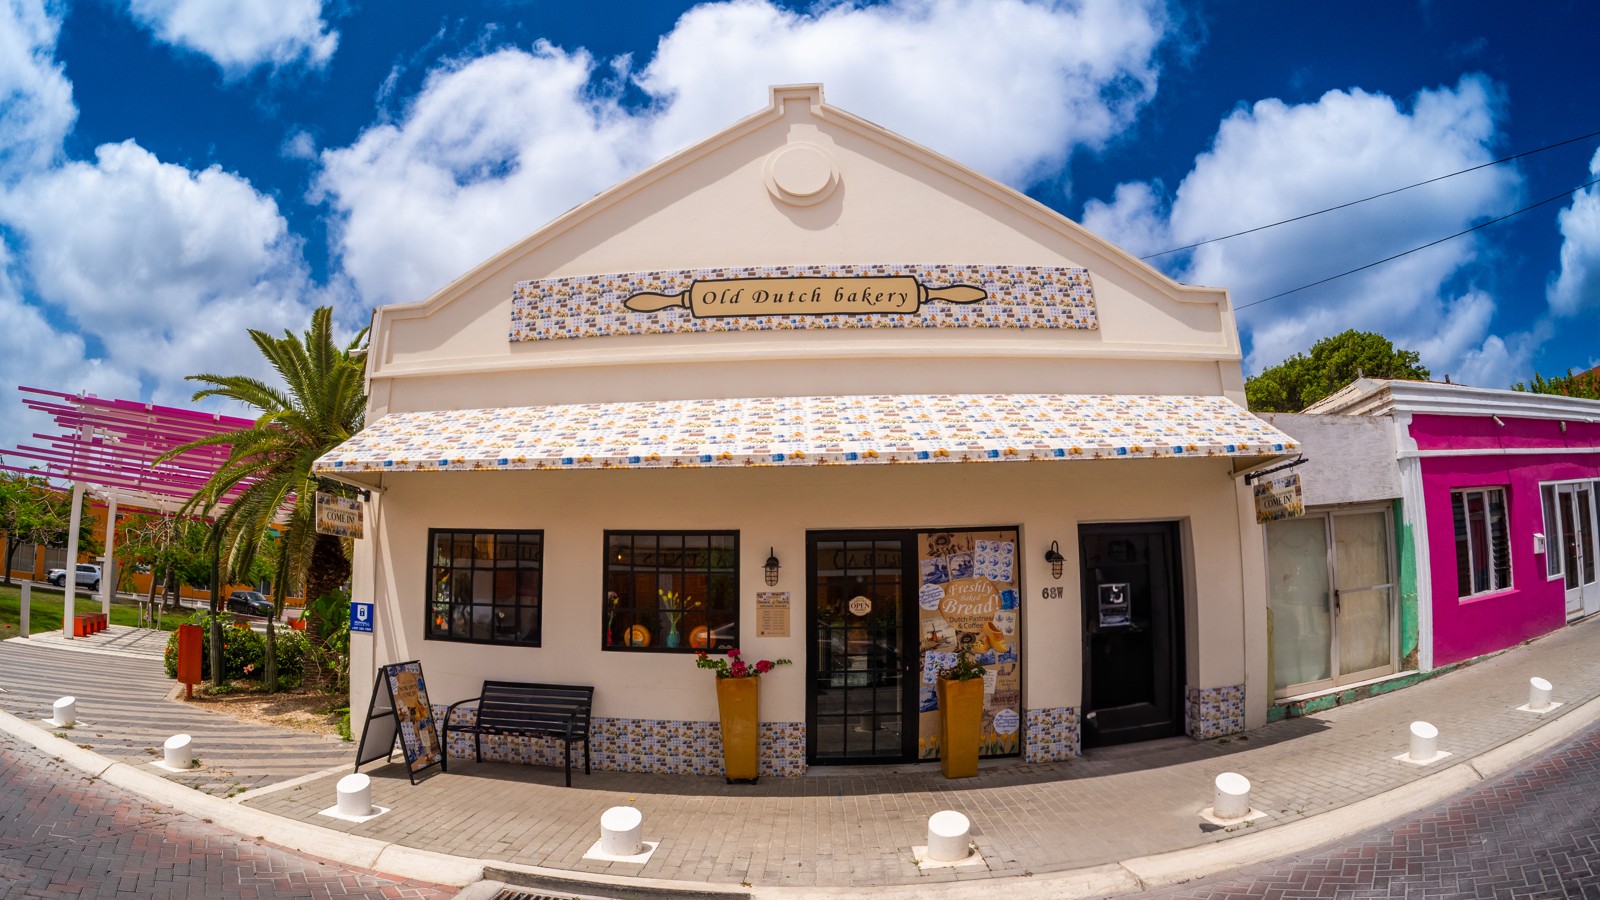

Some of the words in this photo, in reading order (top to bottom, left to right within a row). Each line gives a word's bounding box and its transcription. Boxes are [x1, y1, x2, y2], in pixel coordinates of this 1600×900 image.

[702, 288, 744, 304] Old
[752, 287, 822, 304] Dutch
[834, 286, 908, 307] bakery
[1263, 496, 1283, 509] COME
[326, 511, 346, 523] COME
[949, 581, 993, 597] Freshly
[1042, 587, 1063, 599] 68W
[943, 594, 1000, 615] Bread!
